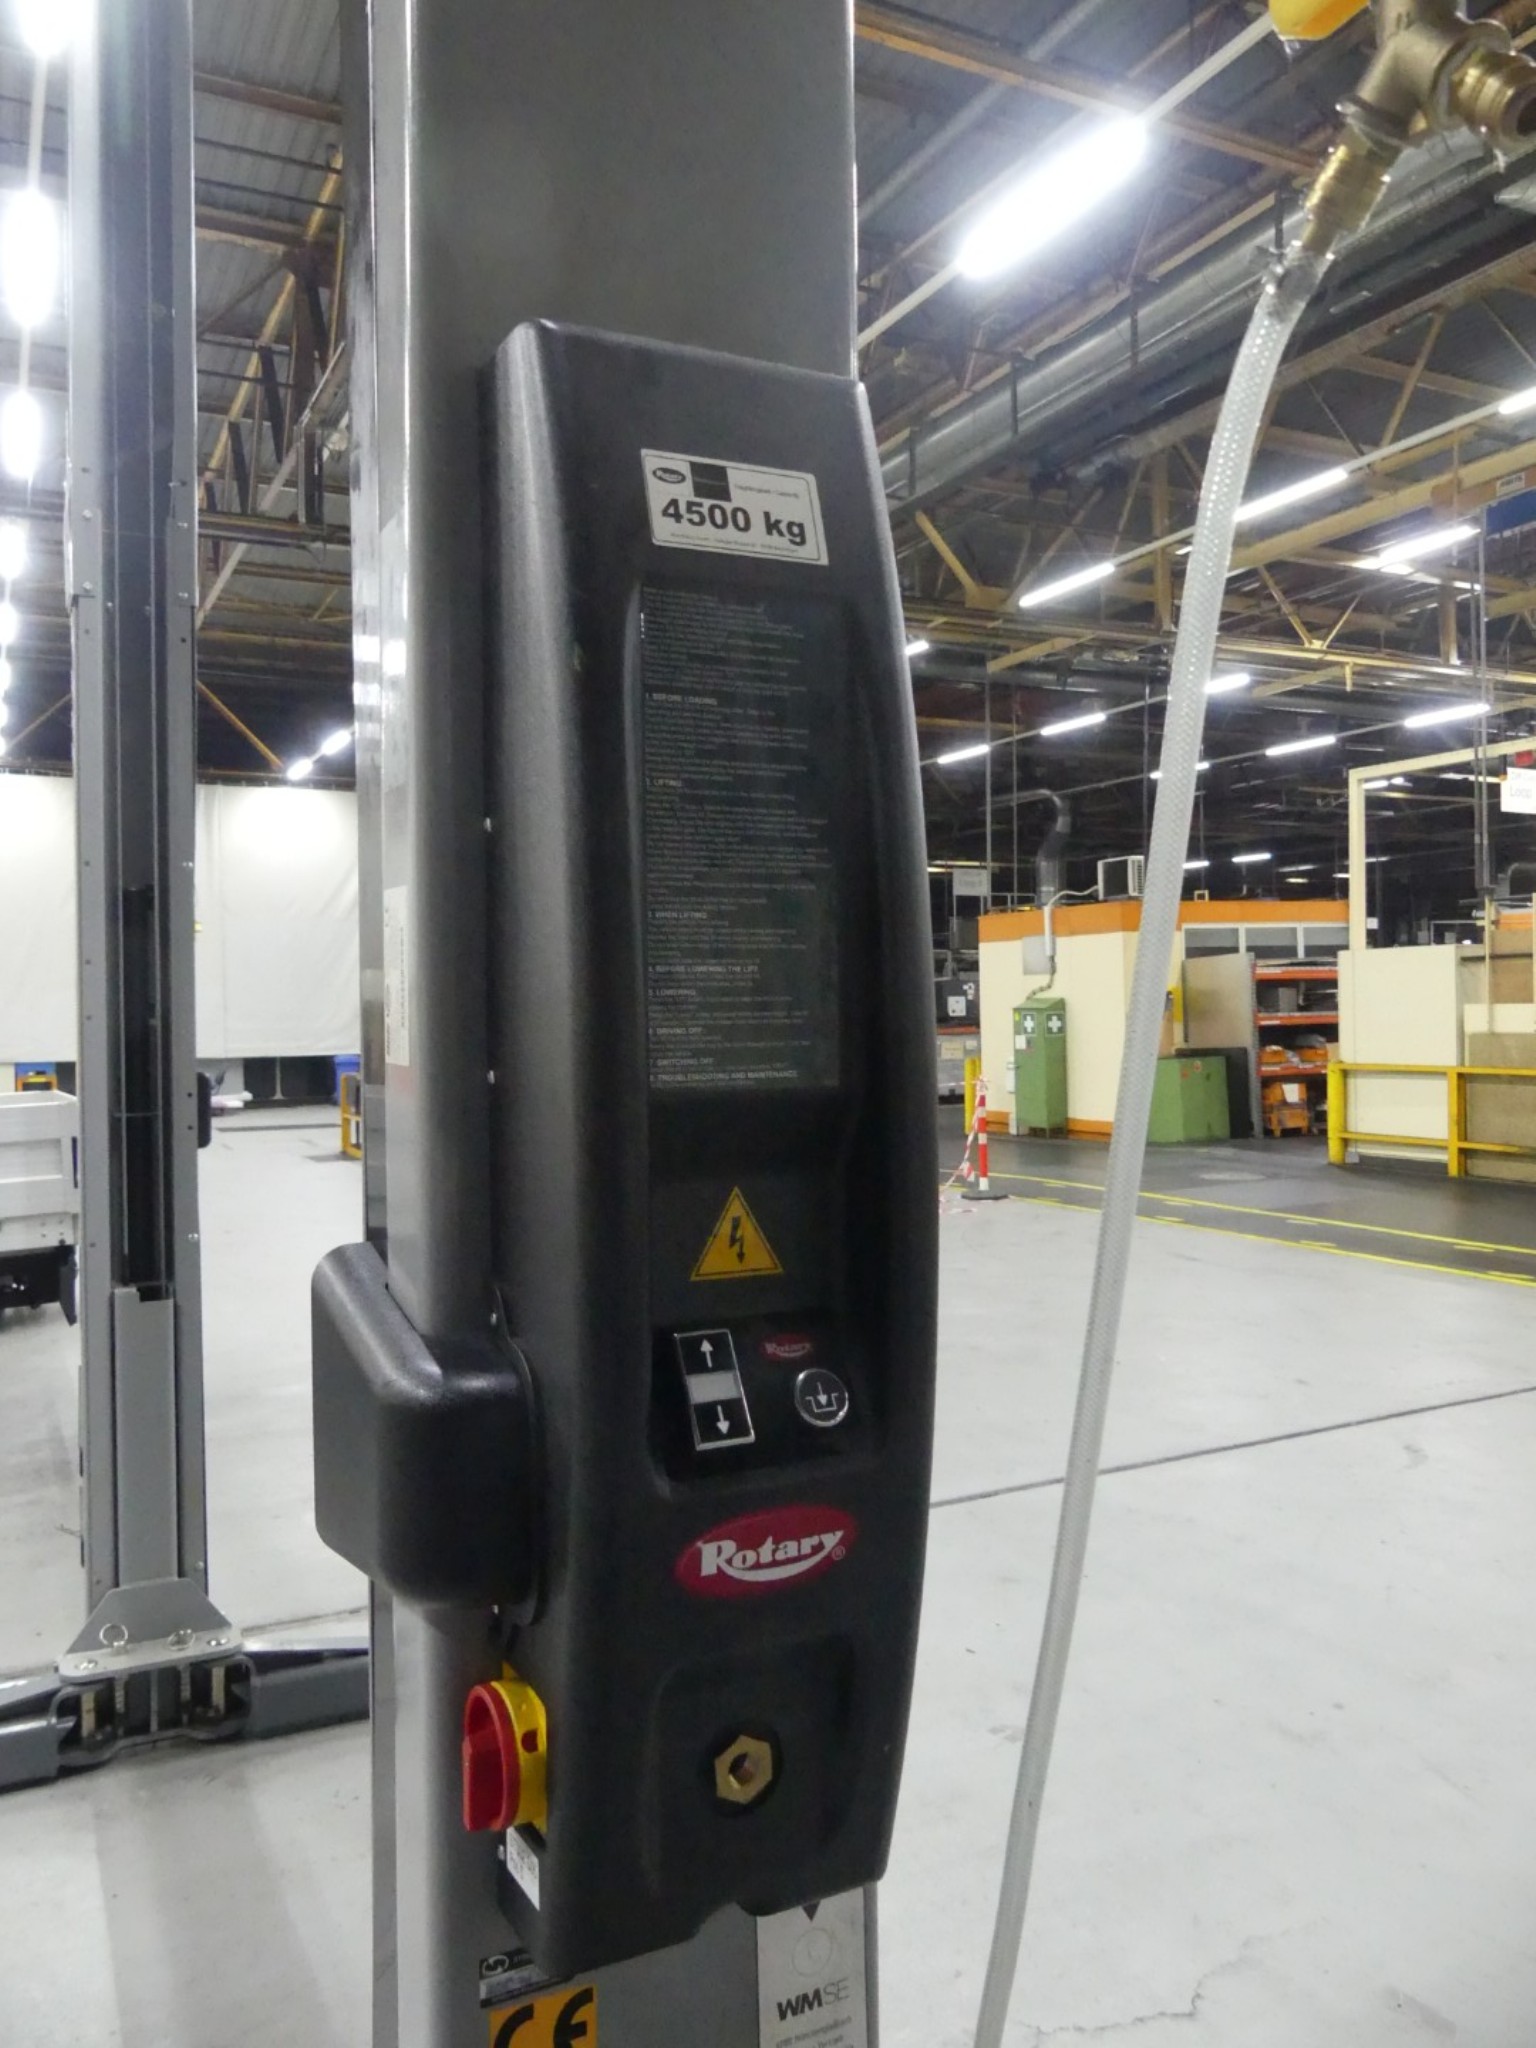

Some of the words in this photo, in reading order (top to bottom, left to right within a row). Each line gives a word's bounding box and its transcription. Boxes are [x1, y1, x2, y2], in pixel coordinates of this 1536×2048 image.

[661, 498, 751, 533] 4500
[763, 511, 807, 547] kg
[764, 1339, 813, 1358] Rotary
[697, 1530, 845, 1583] Rotary
[776, 1976, 850, 2021] WMSE
